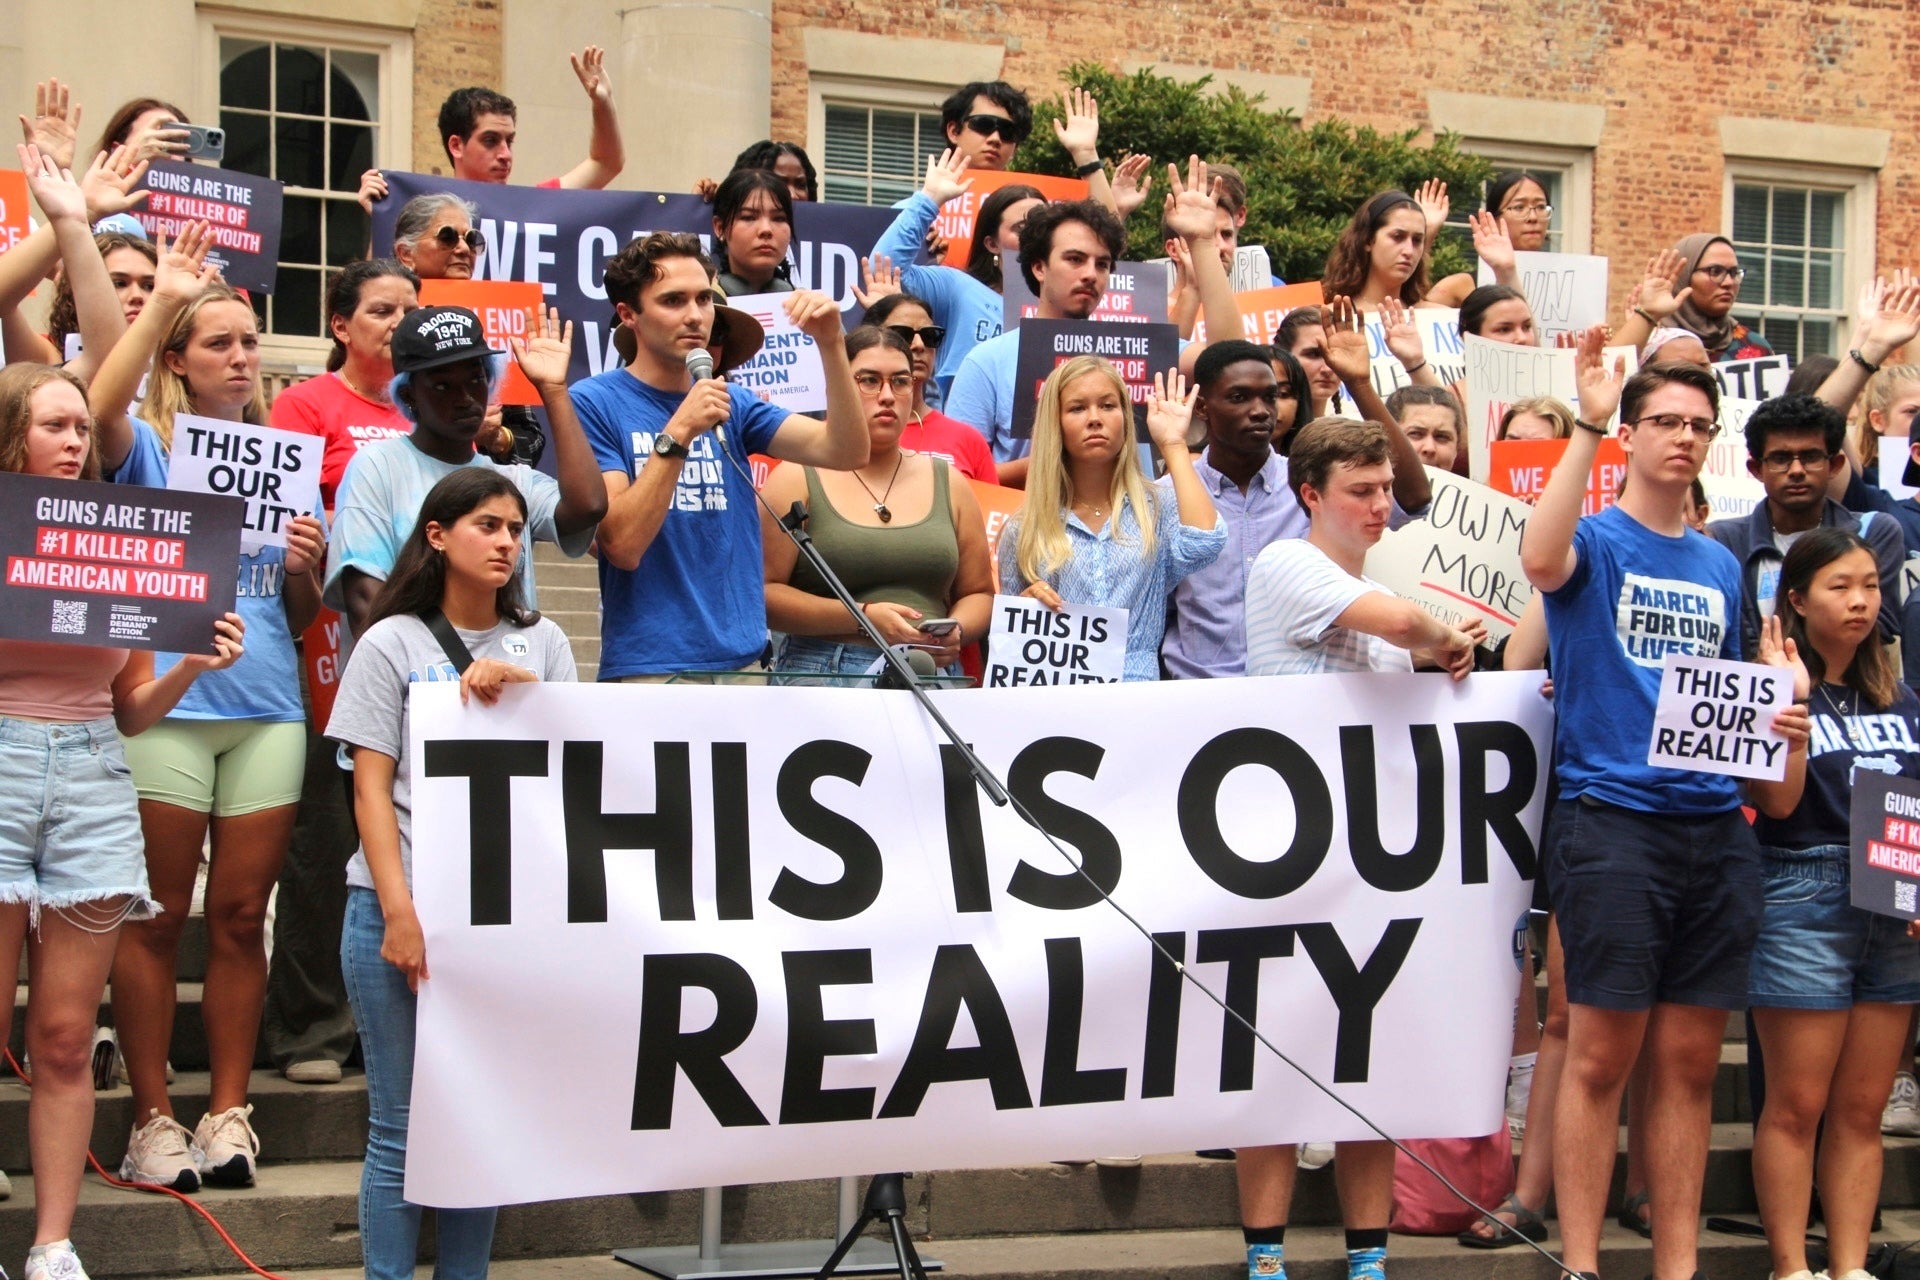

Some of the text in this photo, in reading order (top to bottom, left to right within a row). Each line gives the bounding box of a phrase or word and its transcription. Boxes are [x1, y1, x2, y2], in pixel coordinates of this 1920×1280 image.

[148, 170, 252, 206] GUNS ARE THE
[945, 191, 974, 215] WE
[152, 194, 246, 226] #1 KILLER OF
[215, 227, 261, 252] YOUTH
[1109, 274, 1134, 290] THE
[1111, 294, 1130, 310] OF
[417, 312, 473, 337] BROOKLYN
[434, 324, 464, 340] 1947
[486, 306, 526, 335] END
[435, 337, 473, 350] NEW YORK
[1054, 334, 1148, 356] GUNS ARE THE
[732, 369, 789, 387] CTION
[1128, 360, 1145, 378] OF
[1472, 342, 1557, 398] PROTECT
[780, 386, 810, 394] AMERICA
[187, 427, 302, 472] THIS IS
[208, 464, 282, 502] OUR
[1509, 466, 1544, 494] WE
[36, 497, 192, 534] GUNS ARE THE
[40, 530, 182, 564] #1 KILLER OF
[10, 560, 127, 592] AMERICAN
[134, 570, 205, 599] YOUTH
[1422, 544, 1526, 619] MORE
[1631, 584, 1710, 616] MARCH
[109, 628, 142, 636] ACTION
[110, 614, 158, 624] STUDENTS
[110, 620, 148, 630] DEMAND
[1004, 607, 1108, 643] THIS IS
[1630, 610, 1720, 646] FOR OUR
[1022, 638, 1090, 670] OUR
[1627, 634, 1695, 660] LIVES
[1675, 667, 1775, 705] THIS IS
[1690, 701, 1757, 734] OUR
[1656, 728, 1784, 768] REALITY
[423, 720, 1537, 927] THIS IS OUR
[1888, 821, 1904, 840] #1
[629, 916, 1423, 1133] REALITY
